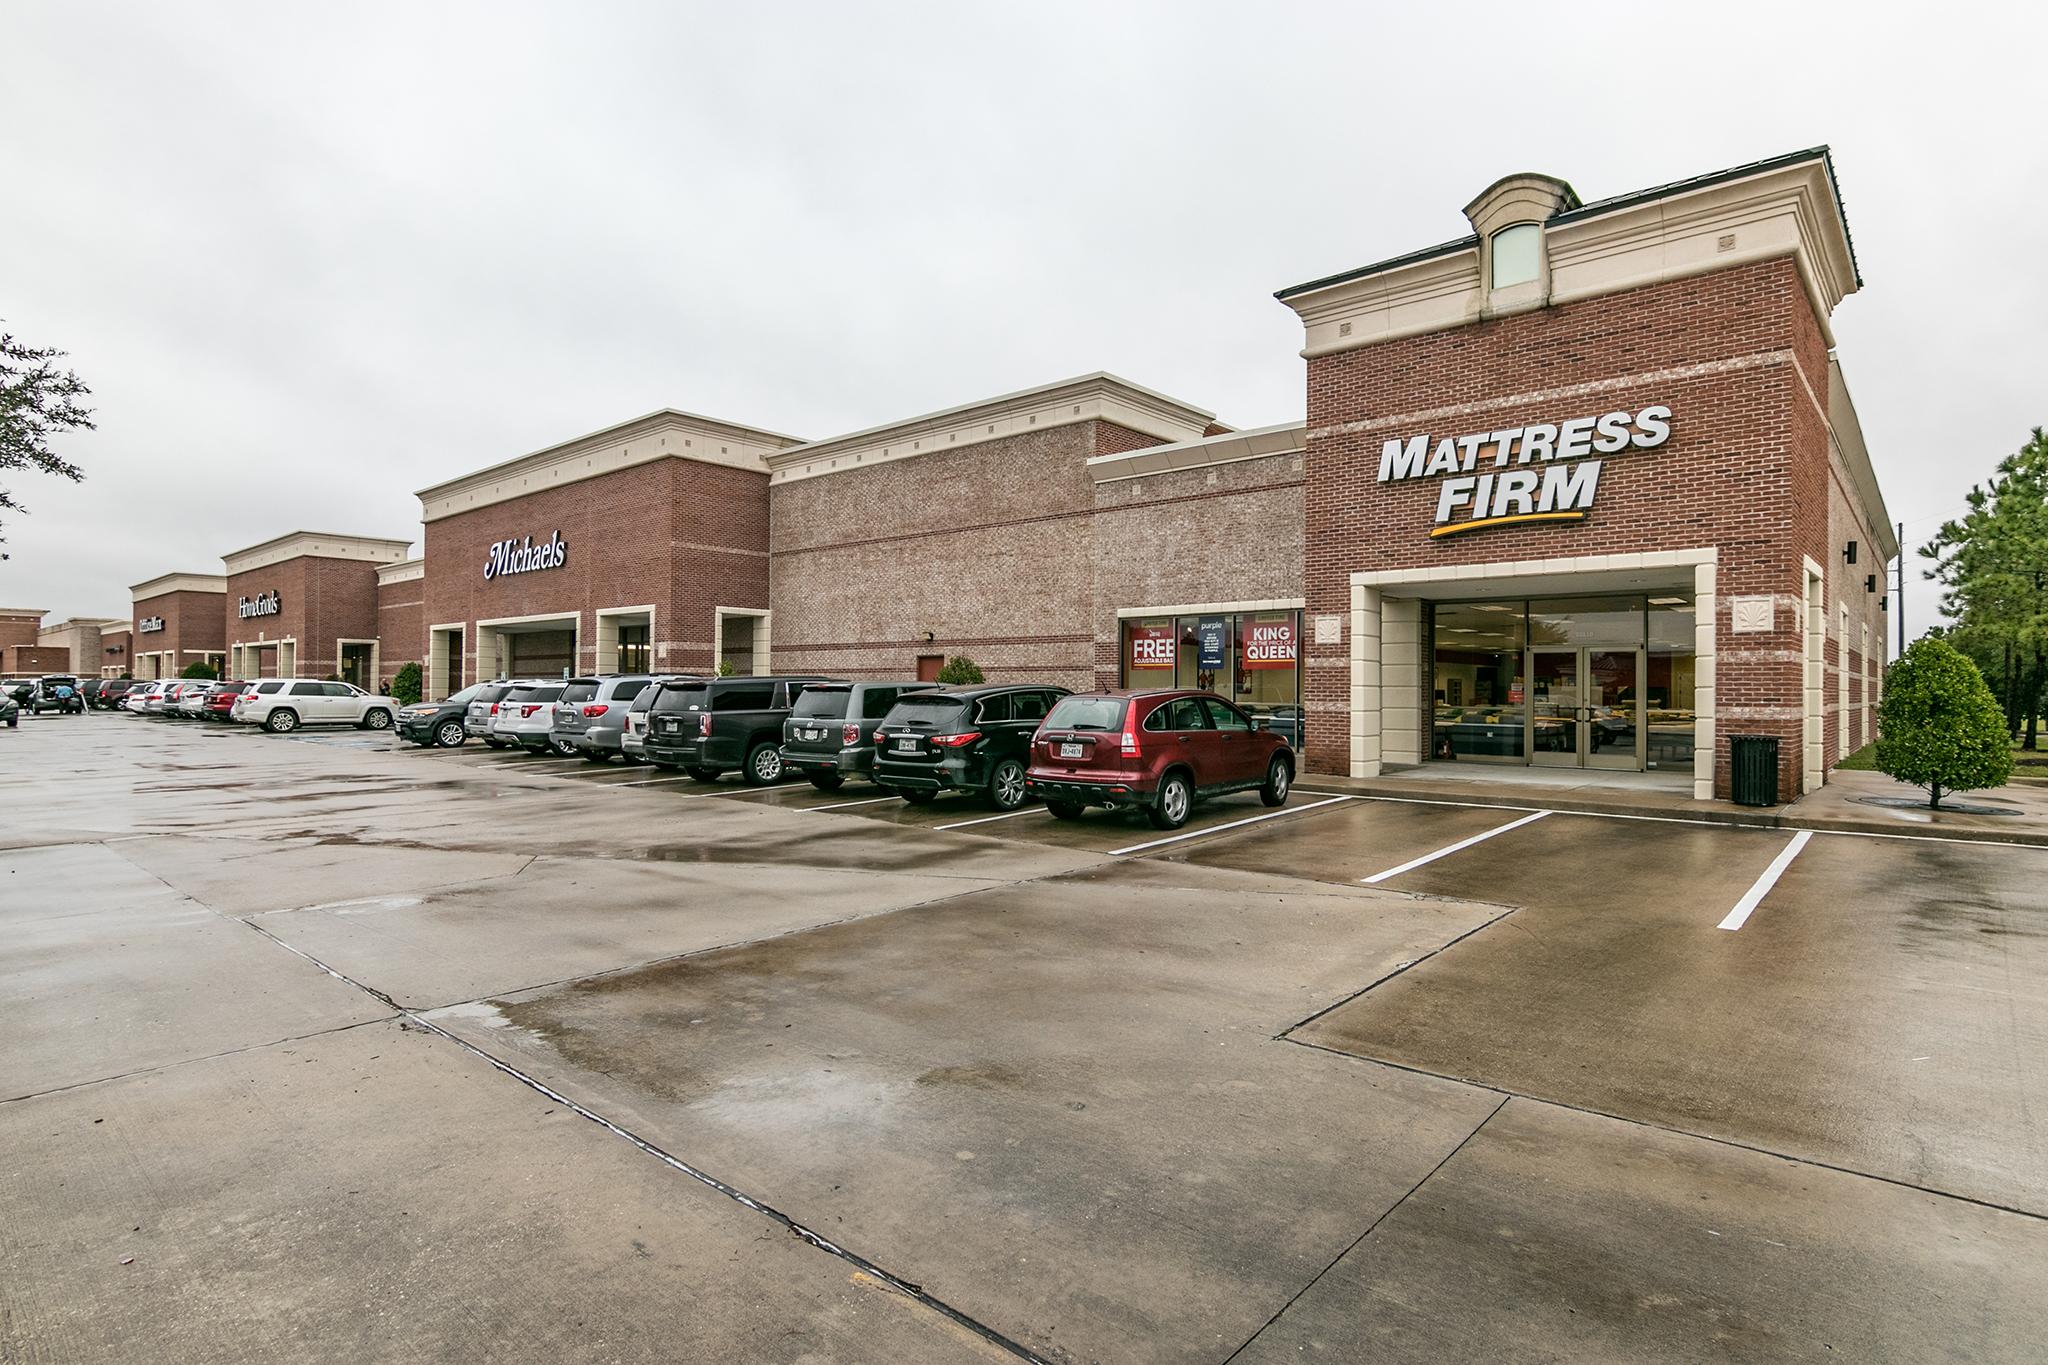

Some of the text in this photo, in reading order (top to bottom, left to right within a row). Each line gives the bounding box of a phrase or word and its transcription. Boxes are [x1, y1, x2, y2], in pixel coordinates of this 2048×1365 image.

[1377, 405, 1673, 483] MATTRESS
[1434, 460, 1602, 523] FIRM
[483, 529, 566, 580] Michaels
[1201, 621, 1223, 631] purple
[1253, 626, 1290, 641] KING
[1133, 638, 1174, 658] FREE
[1247, 645, 1296, 660] QUEEN
